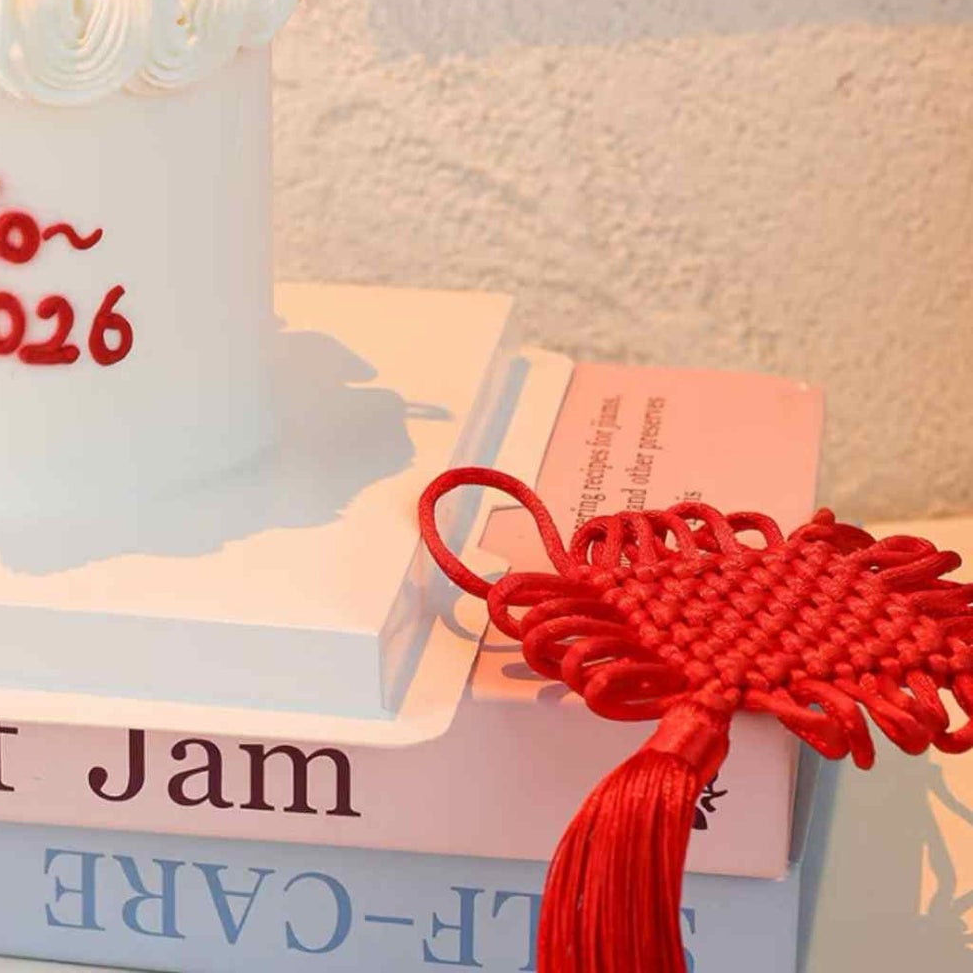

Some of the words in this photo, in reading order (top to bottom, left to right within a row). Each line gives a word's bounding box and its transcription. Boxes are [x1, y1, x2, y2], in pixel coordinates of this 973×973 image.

[586, 429, 612, 447] for
[638, 396, 665, 450] preserves
[579, 448, 614, 490] recipes
[625, 452, 654, 484] other
[88, 728, 362, 818] Jam
[43, 847, 696, 973] LF-CARE
